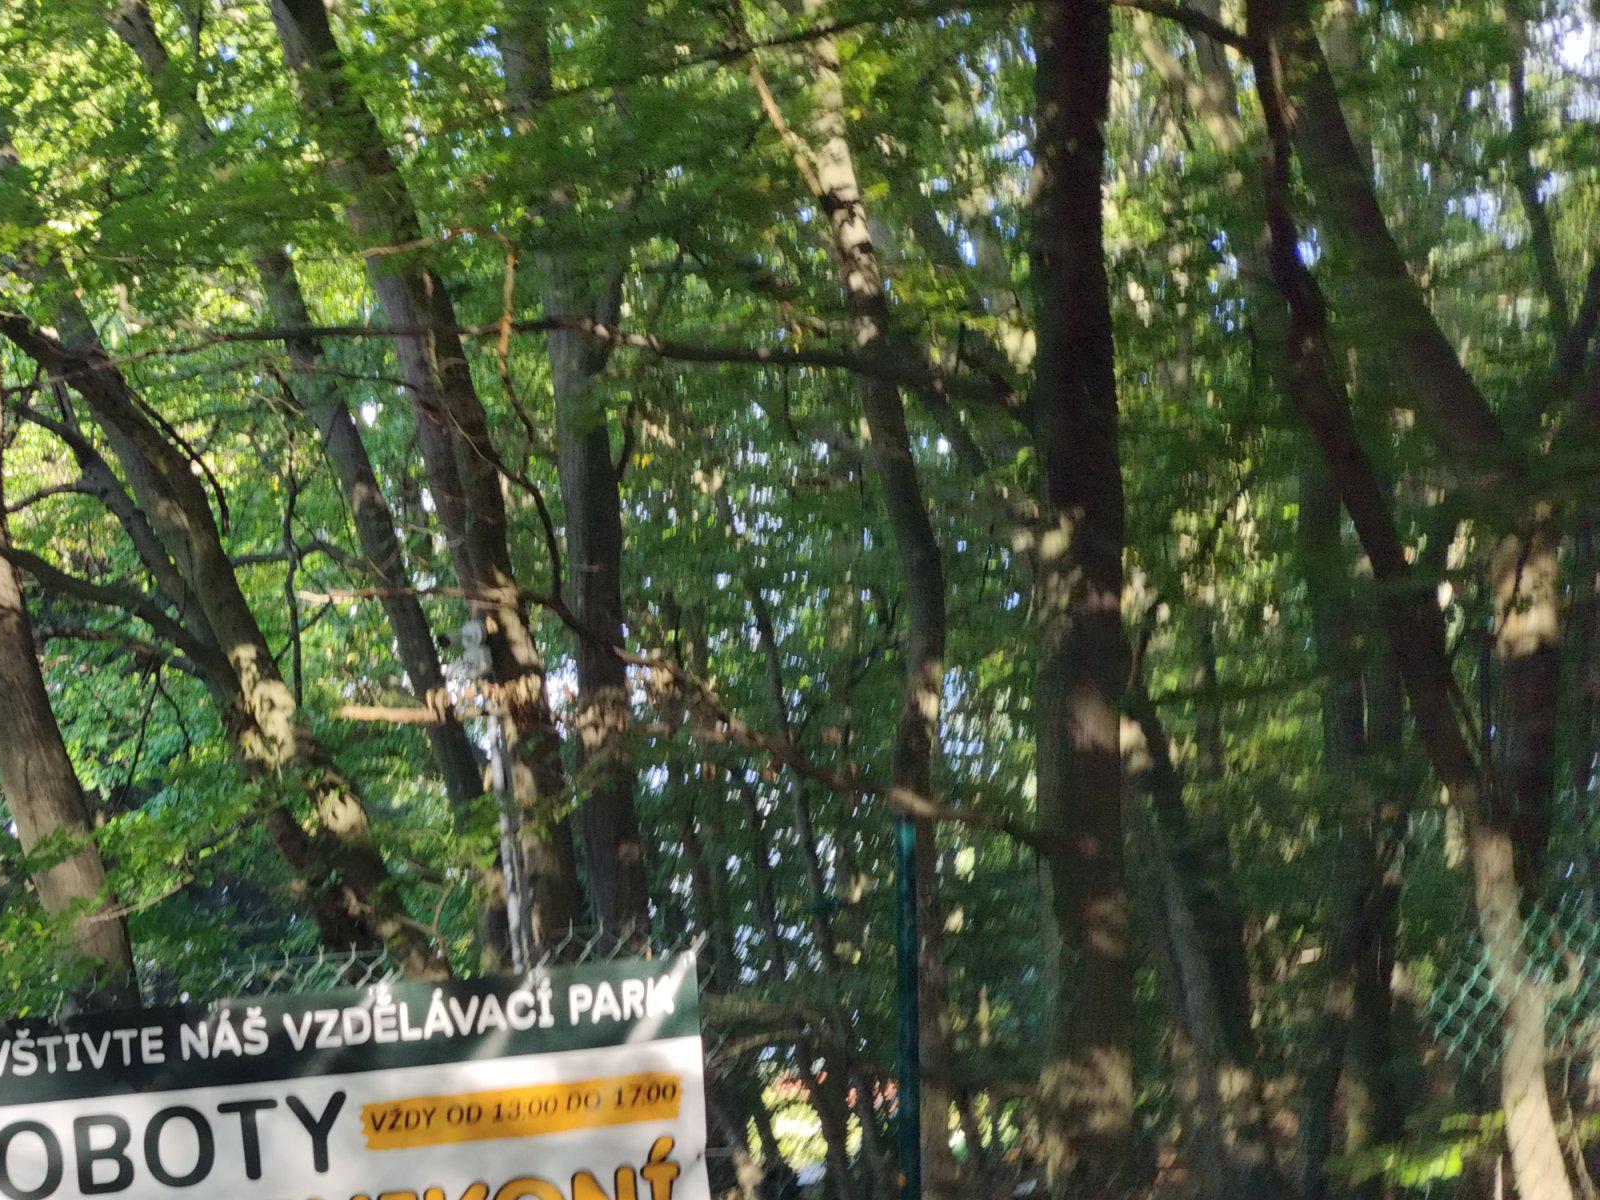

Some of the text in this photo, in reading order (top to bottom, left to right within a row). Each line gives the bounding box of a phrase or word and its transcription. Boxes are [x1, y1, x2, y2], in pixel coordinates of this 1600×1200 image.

[179, 1006, 270, 1062] NÁŠ
[282, 975, 556, 1051] VZDĚLÁVACÍ
[568, 974, 676, 1026] PARK
[370, 1080, 678, 1133] VŽDY OD 13:00 DO 17:00
